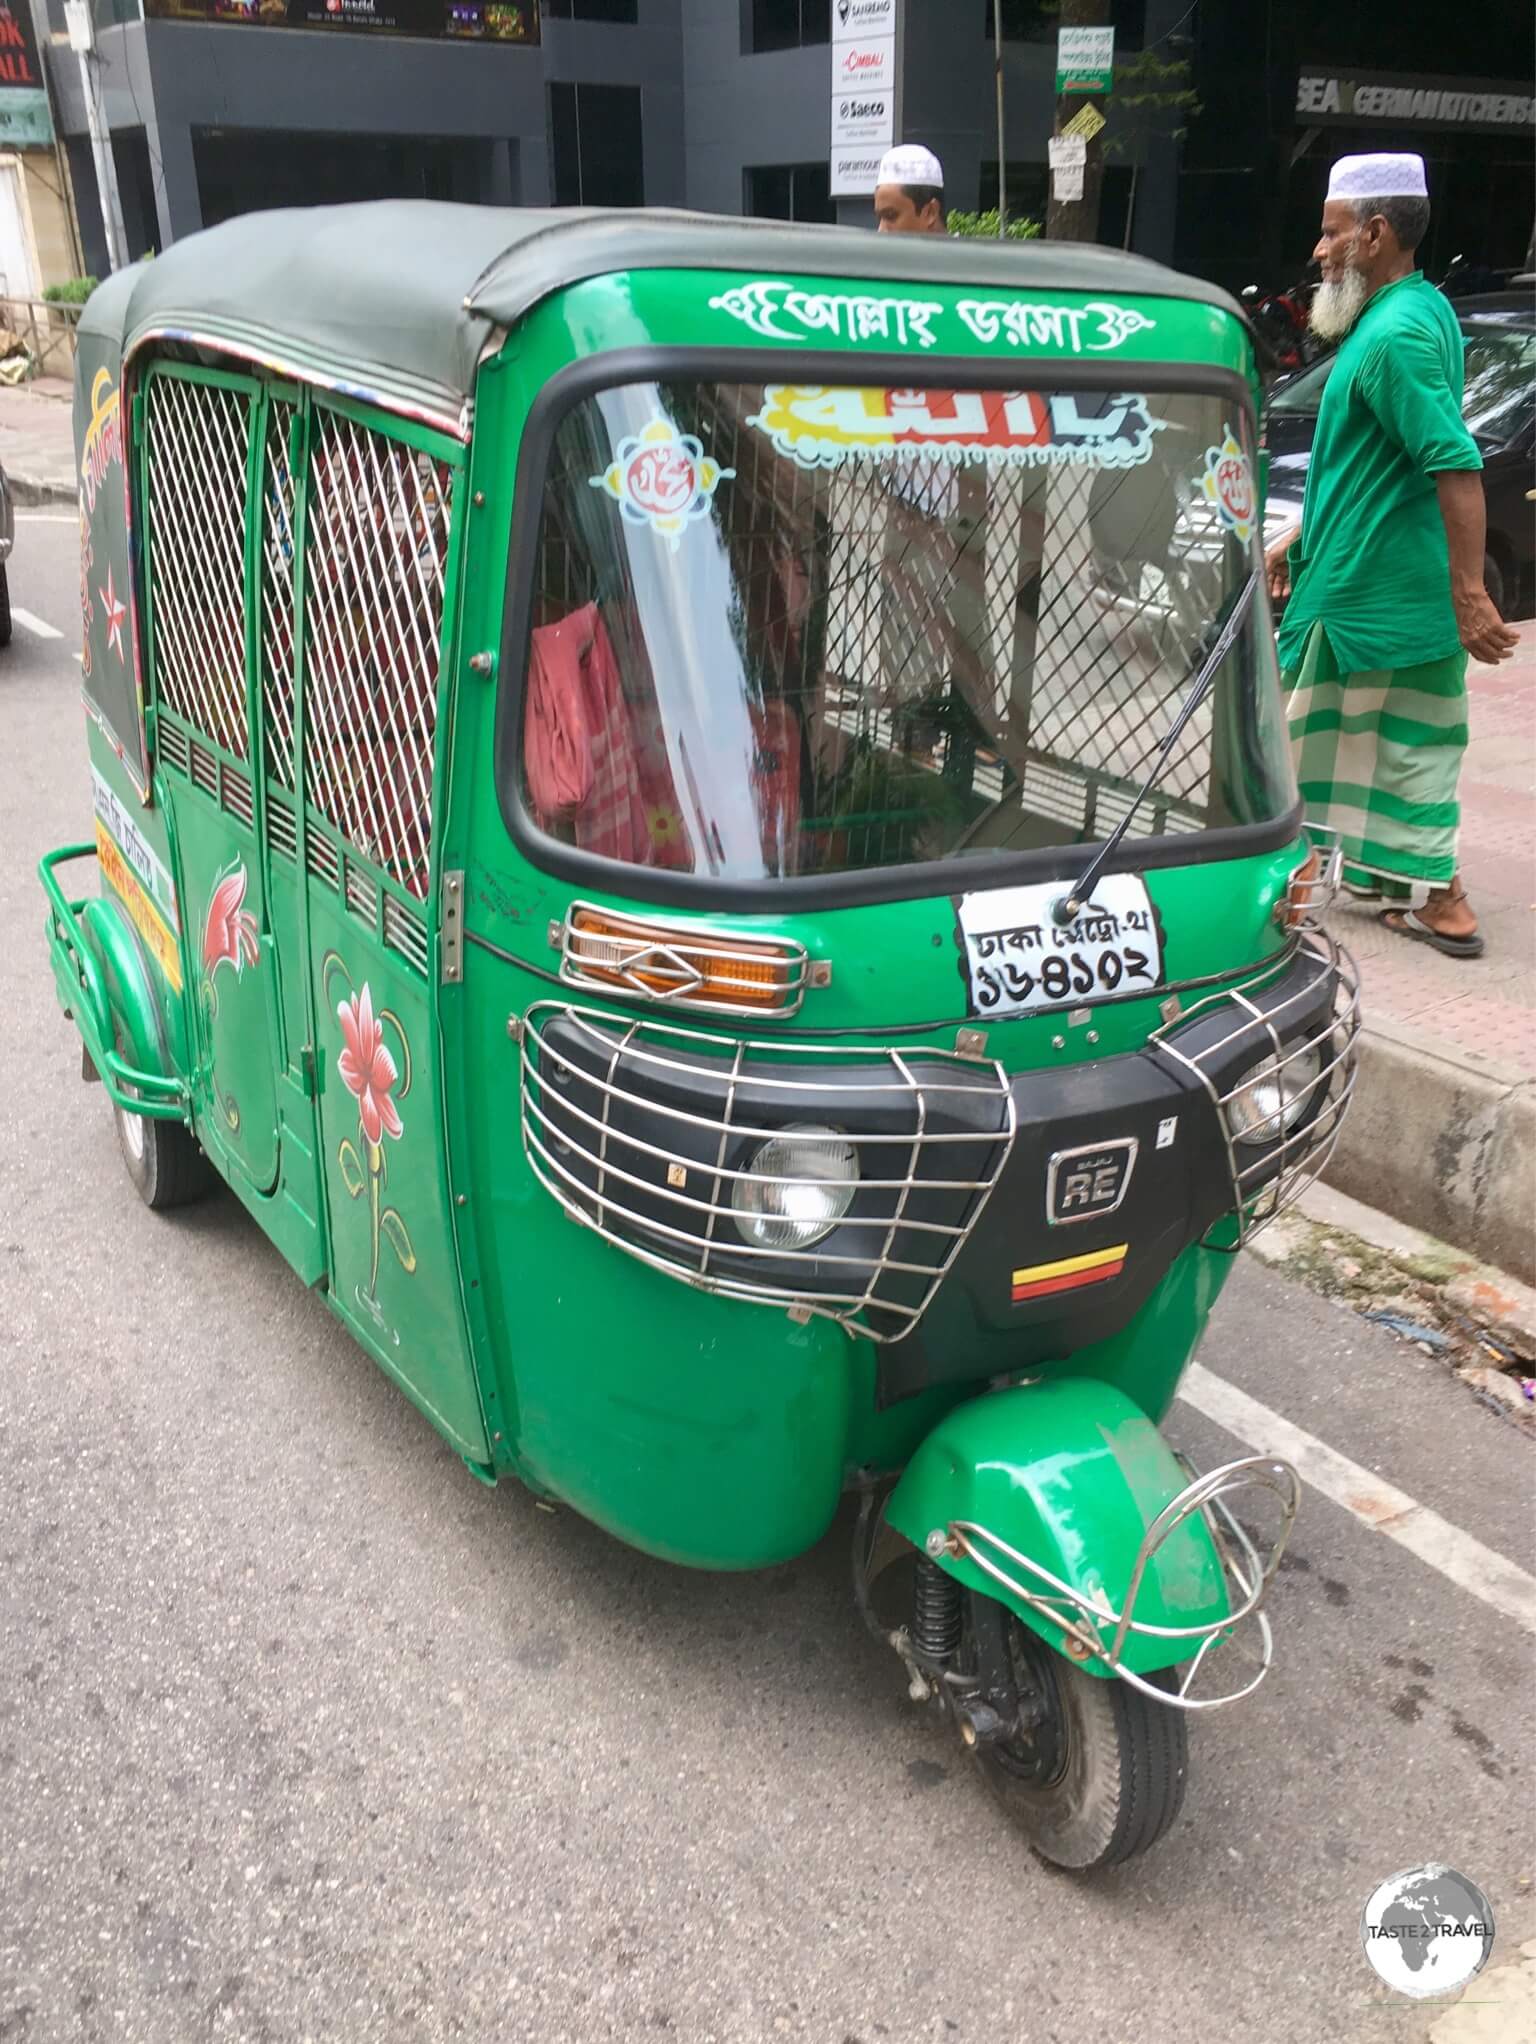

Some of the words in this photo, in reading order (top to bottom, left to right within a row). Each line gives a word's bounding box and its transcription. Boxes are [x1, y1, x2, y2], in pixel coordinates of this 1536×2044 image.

[851, 102, 884, 118] Saeco
[1296, 77, 1340, 112] SEA
[1353, 86, 1441, 119] GERMAN
[1436, 91, 1529, 124] KITCHENS
[968, 923, 1043, 958] ঢাকা
[1062, 1166, 1119, 1208] RE
